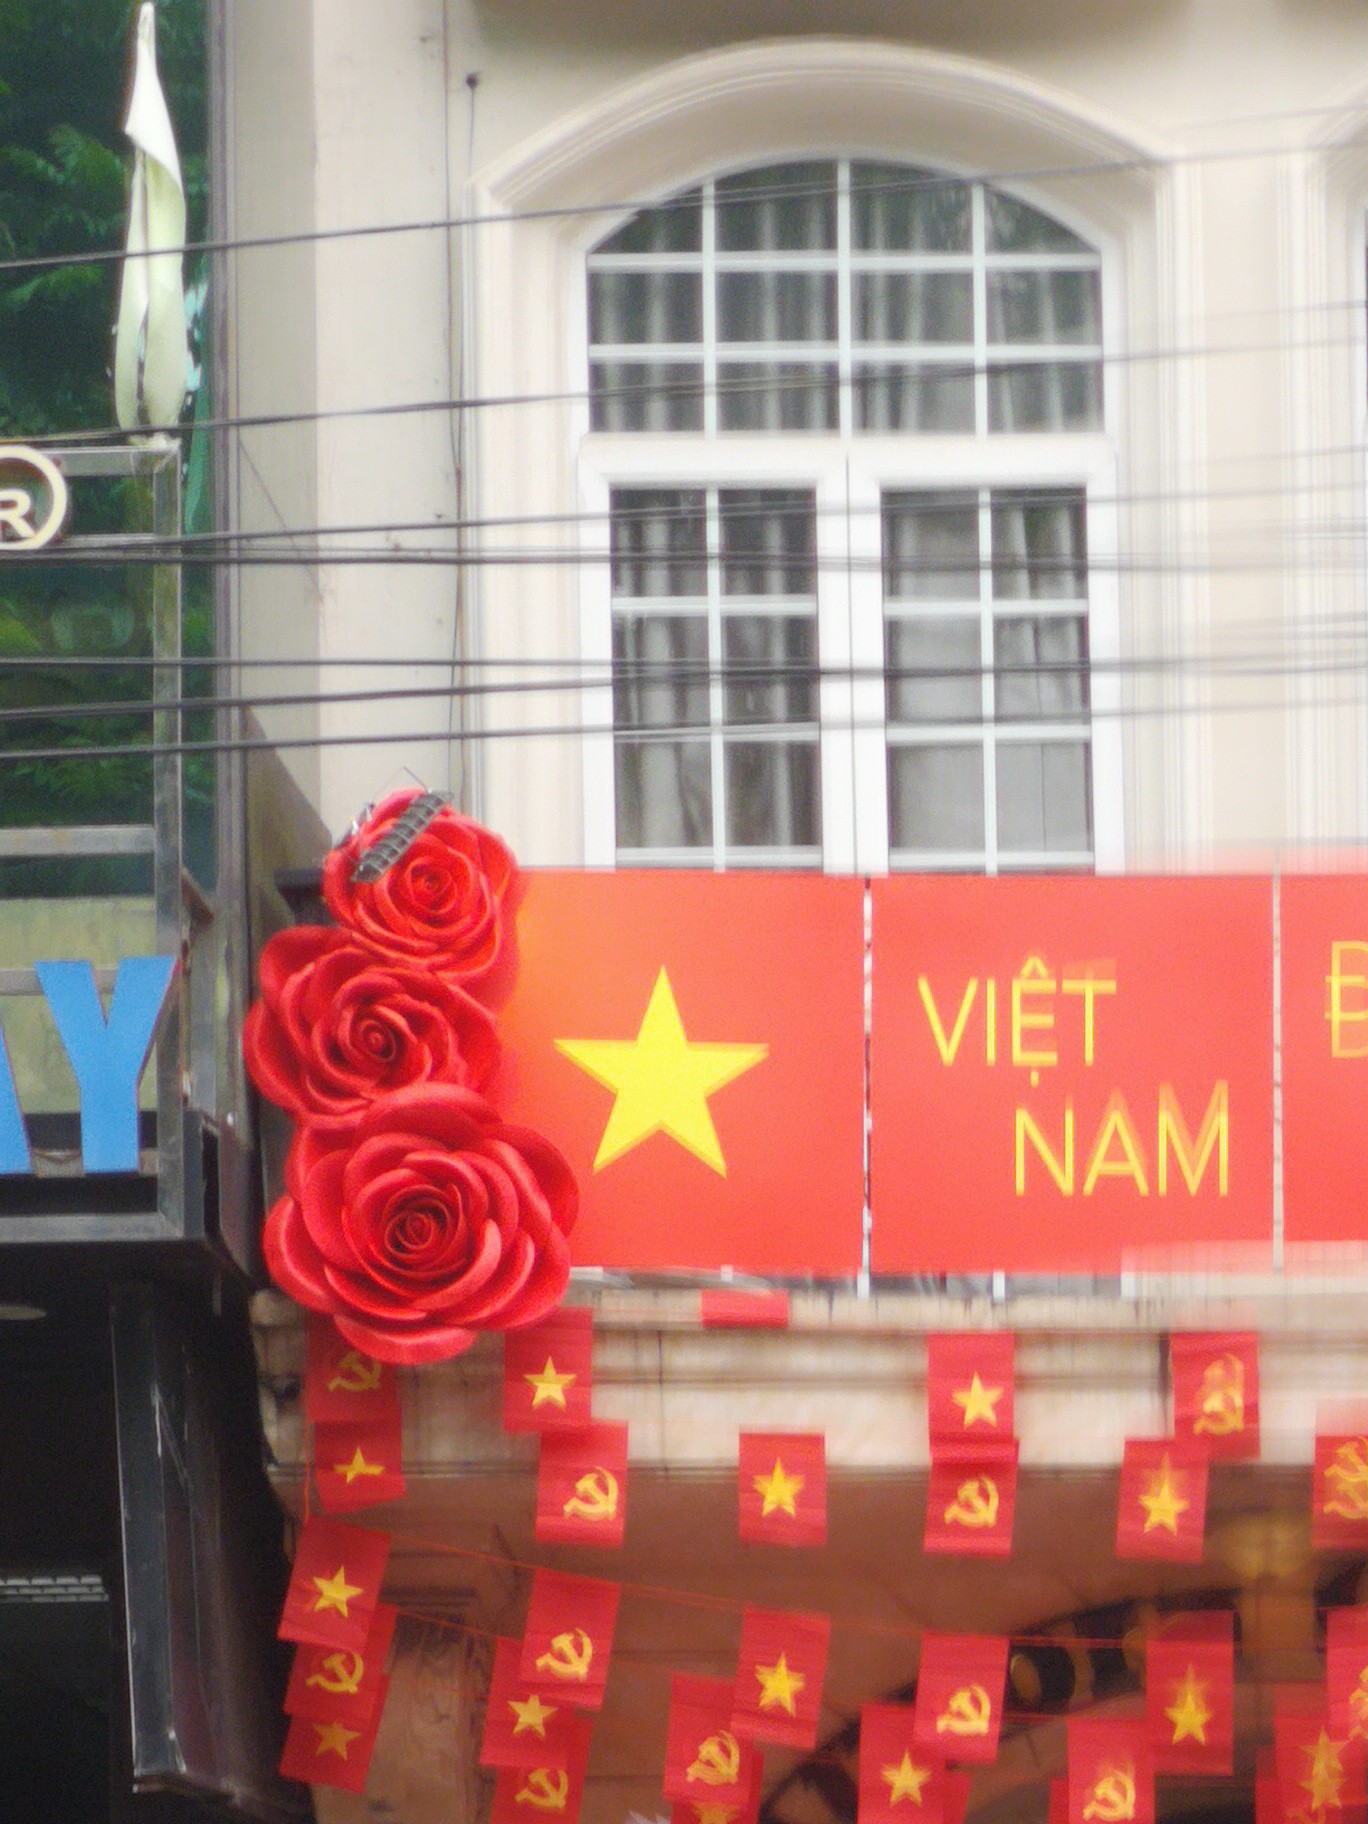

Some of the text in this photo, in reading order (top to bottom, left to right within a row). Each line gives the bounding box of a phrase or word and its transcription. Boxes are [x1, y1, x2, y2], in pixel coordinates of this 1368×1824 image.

[0, 955, 176, 1175] Y
[917, 954, 1118, 1088] VIỆT
[1014, 1088, 1229, 1197] NAM
